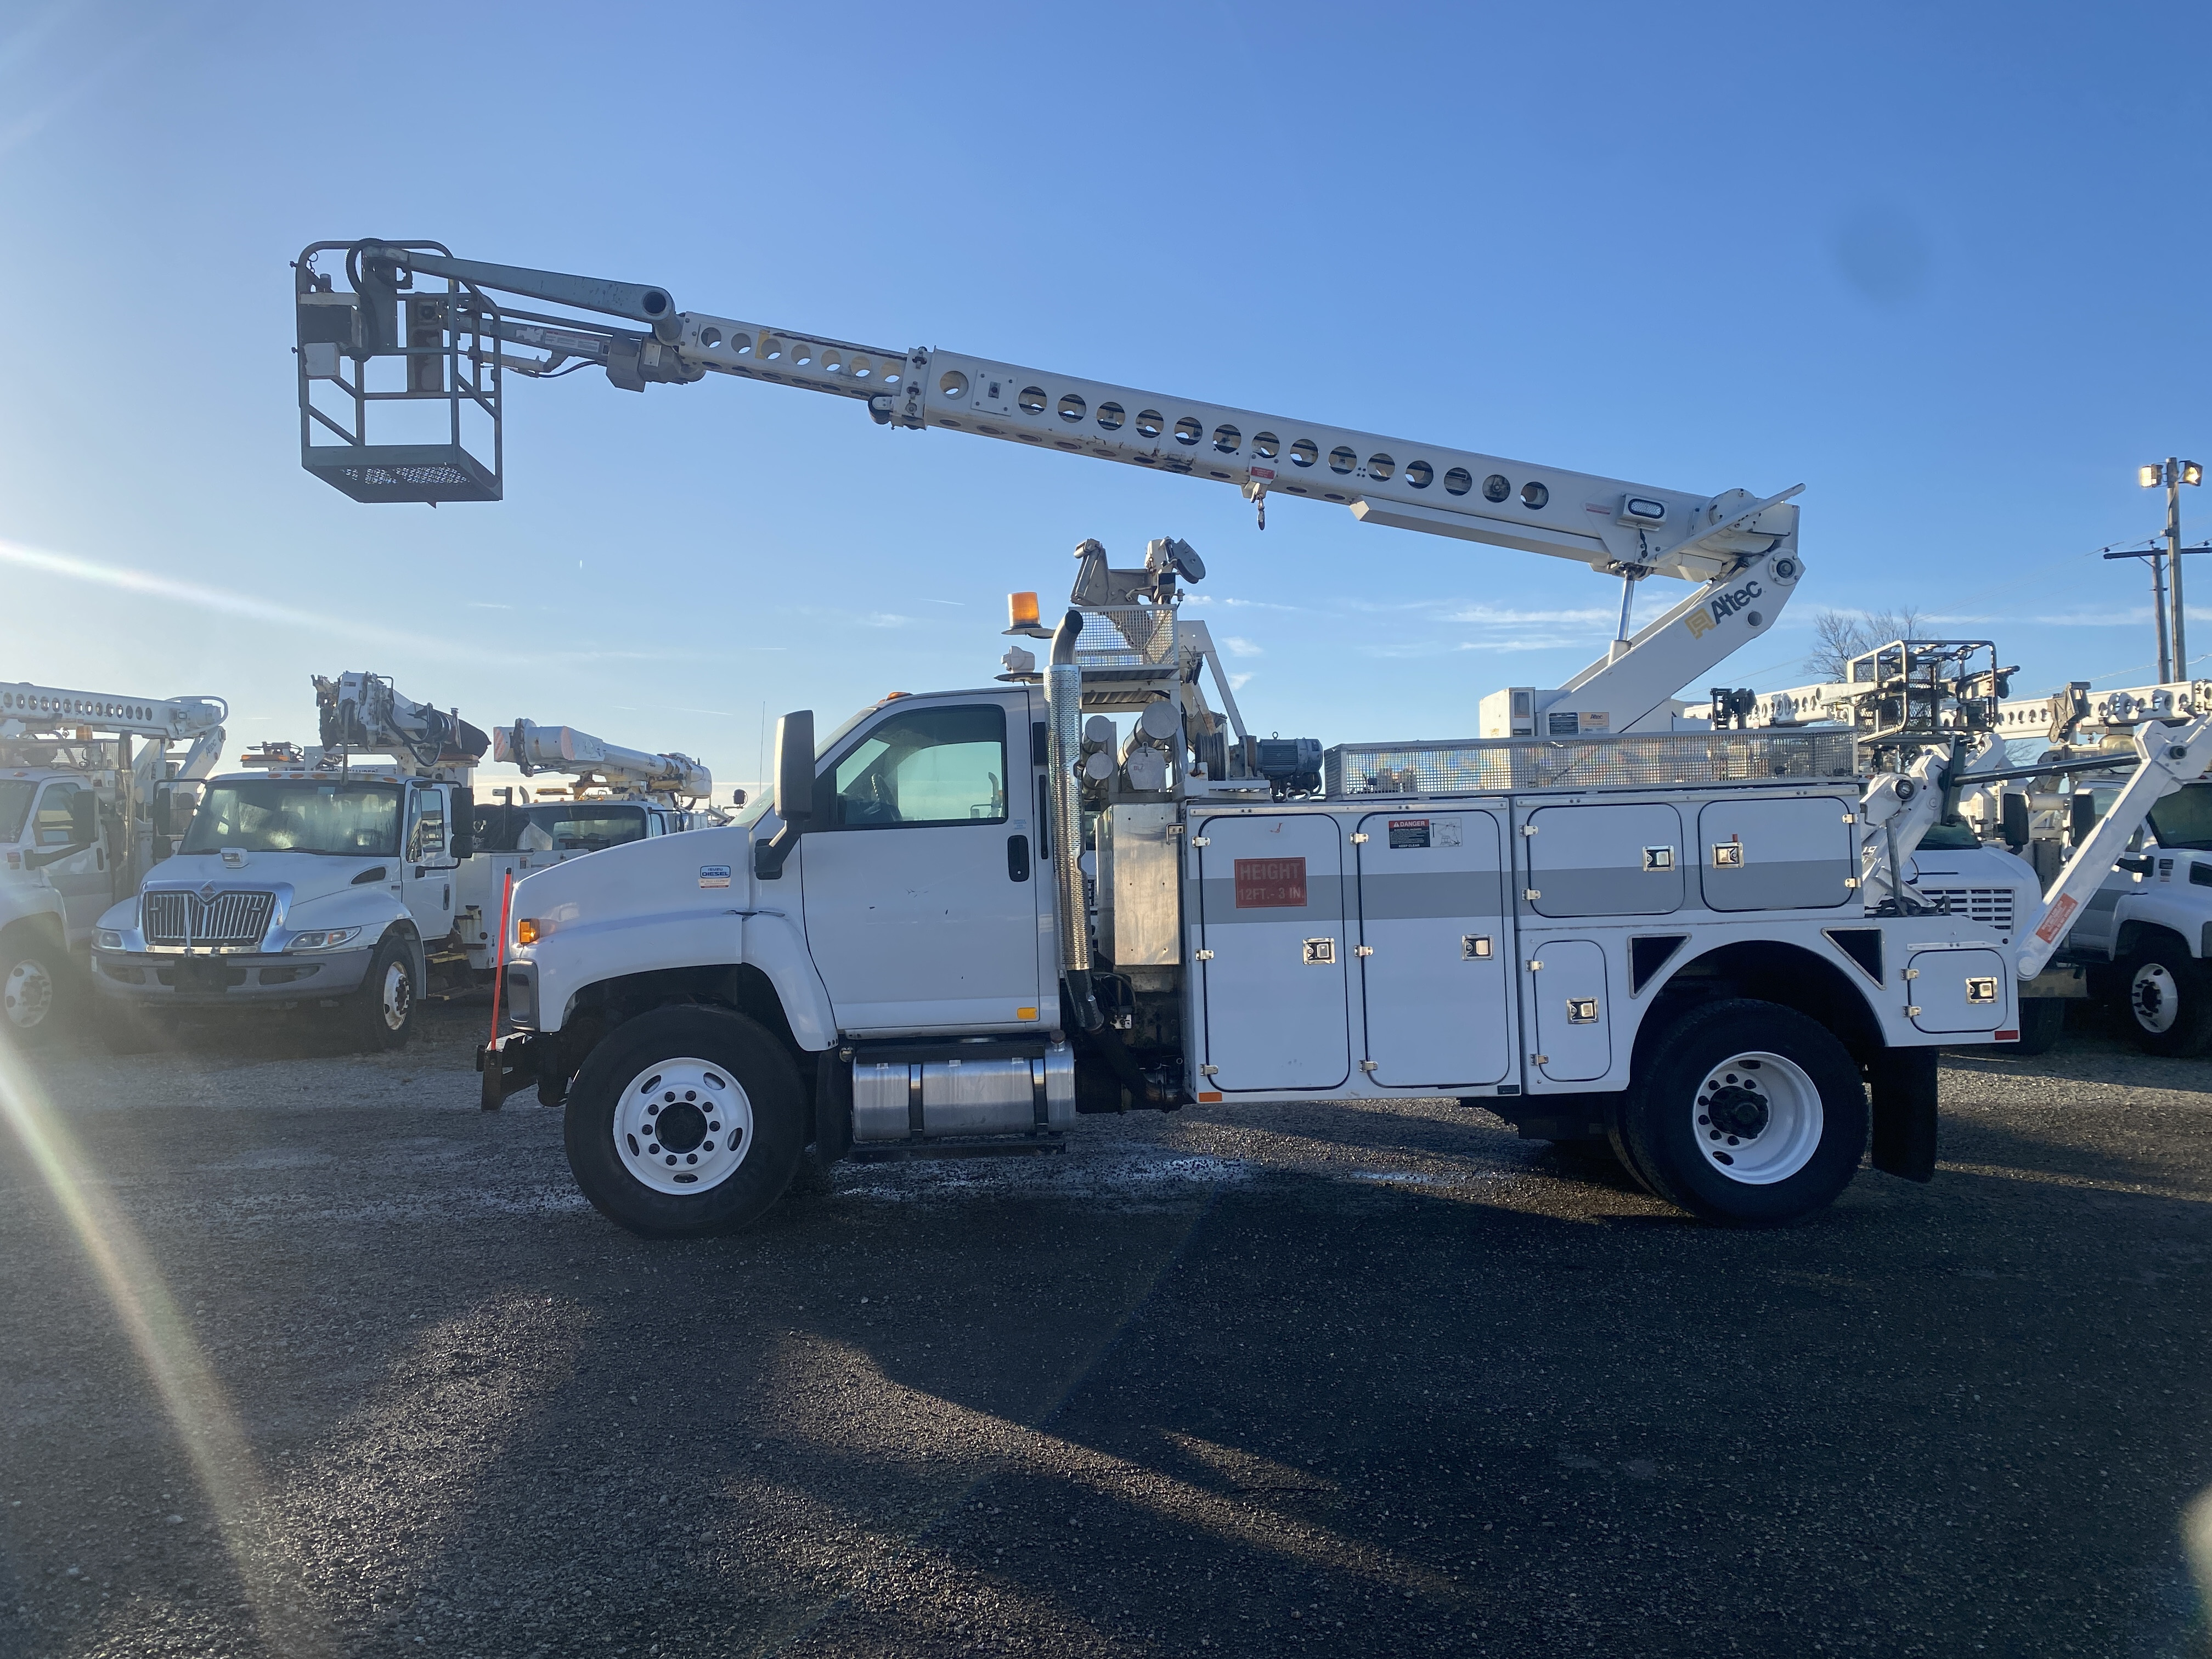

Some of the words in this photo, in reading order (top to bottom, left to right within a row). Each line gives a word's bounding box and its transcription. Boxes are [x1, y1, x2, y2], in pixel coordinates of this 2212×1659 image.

[1711, 580, 1762, 625] Altec
[1240, 863, 1300, 880] HEIGHT
[1279, 888, 1285, 899] 3
